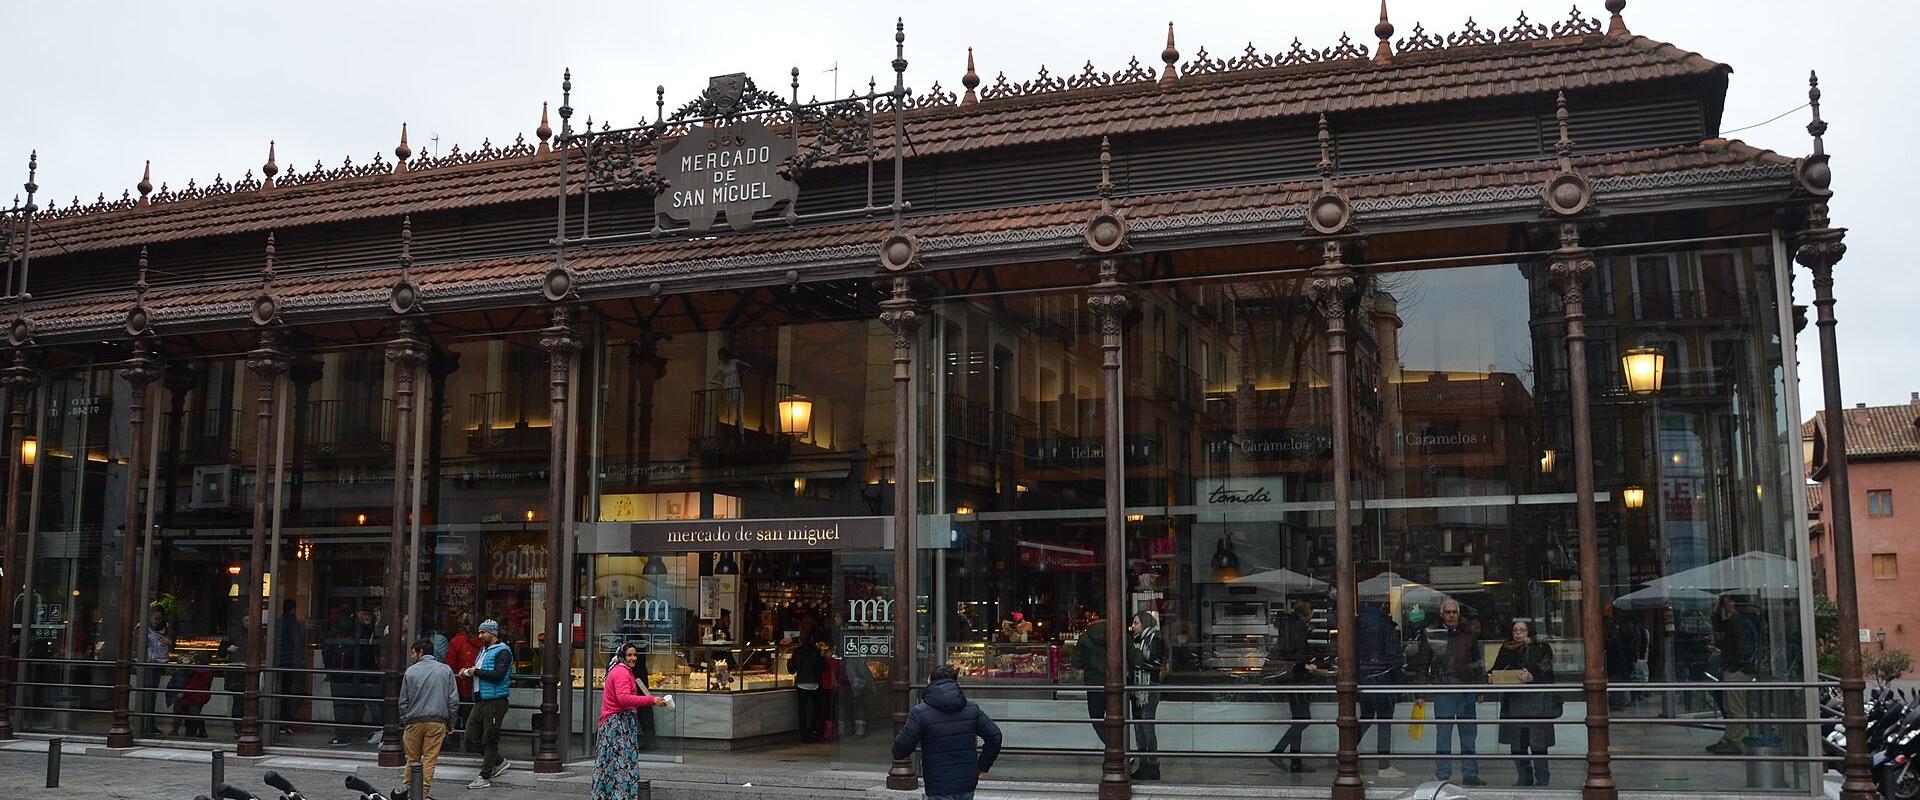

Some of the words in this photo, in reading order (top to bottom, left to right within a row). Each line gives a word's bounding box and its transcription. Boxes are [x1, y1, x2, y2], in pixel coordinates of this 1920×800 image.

[681, 146, 769, 172] MERCADO
[713, 170, 736, 183] DE
[673, 189, 704, 208] SAN
[712, 182, 772, 204] MIGUEL
[1241, 437, 1310, 451] Caramelos
[1406, 431, 1477, 445] Caramelos
[1071, 445, 1104, 459] Helad
[667, 526, 731, 542] mercado
[735, 525, 753, 541] de
[756, 528, 783, 541] san
[787, 523, 840, 546] miguel
